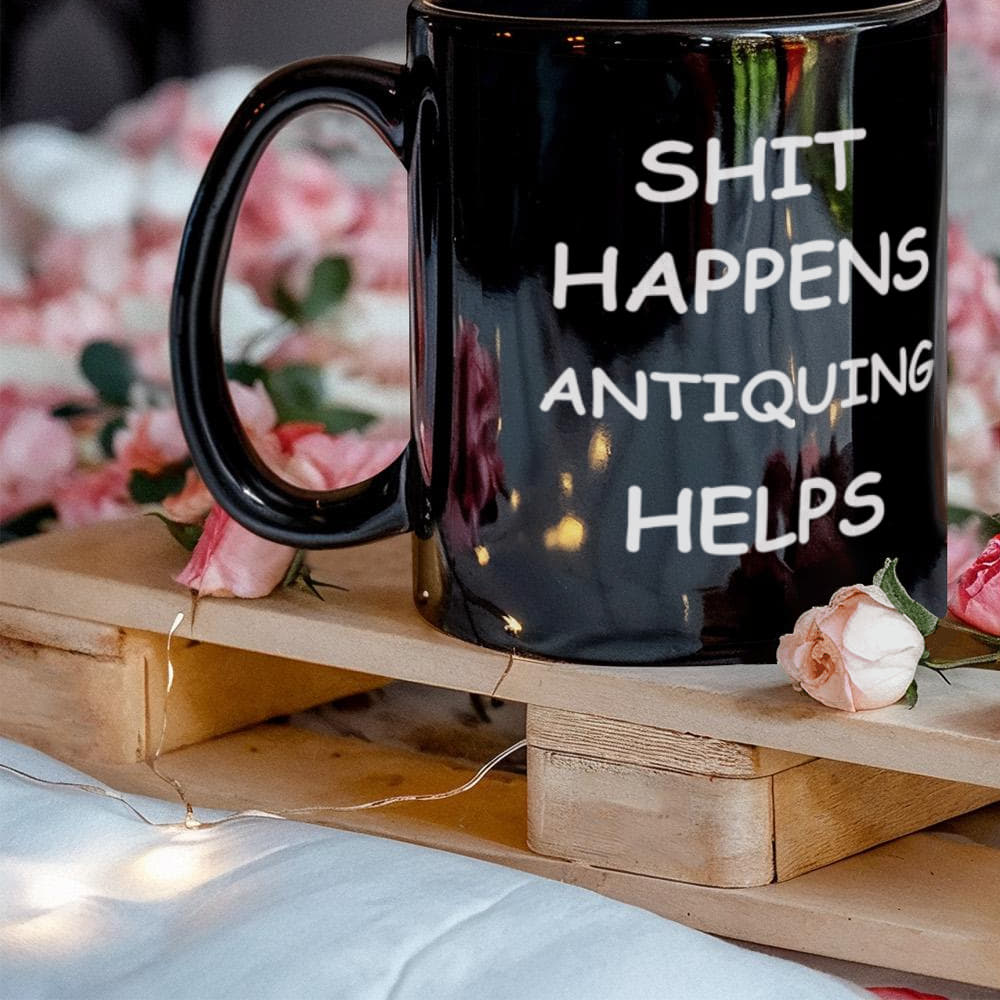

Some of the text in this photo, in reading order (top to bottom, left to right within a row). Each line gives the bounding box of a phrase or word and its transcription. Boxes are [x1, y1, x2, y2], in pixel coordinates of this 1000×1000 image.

[635, 128, 867, 205] SHIT
[553, 226, 930, 315] HAPPENS
[539, 339, 935, 430] ANTIQUING
[625, 471, 885, 556] HELPS
